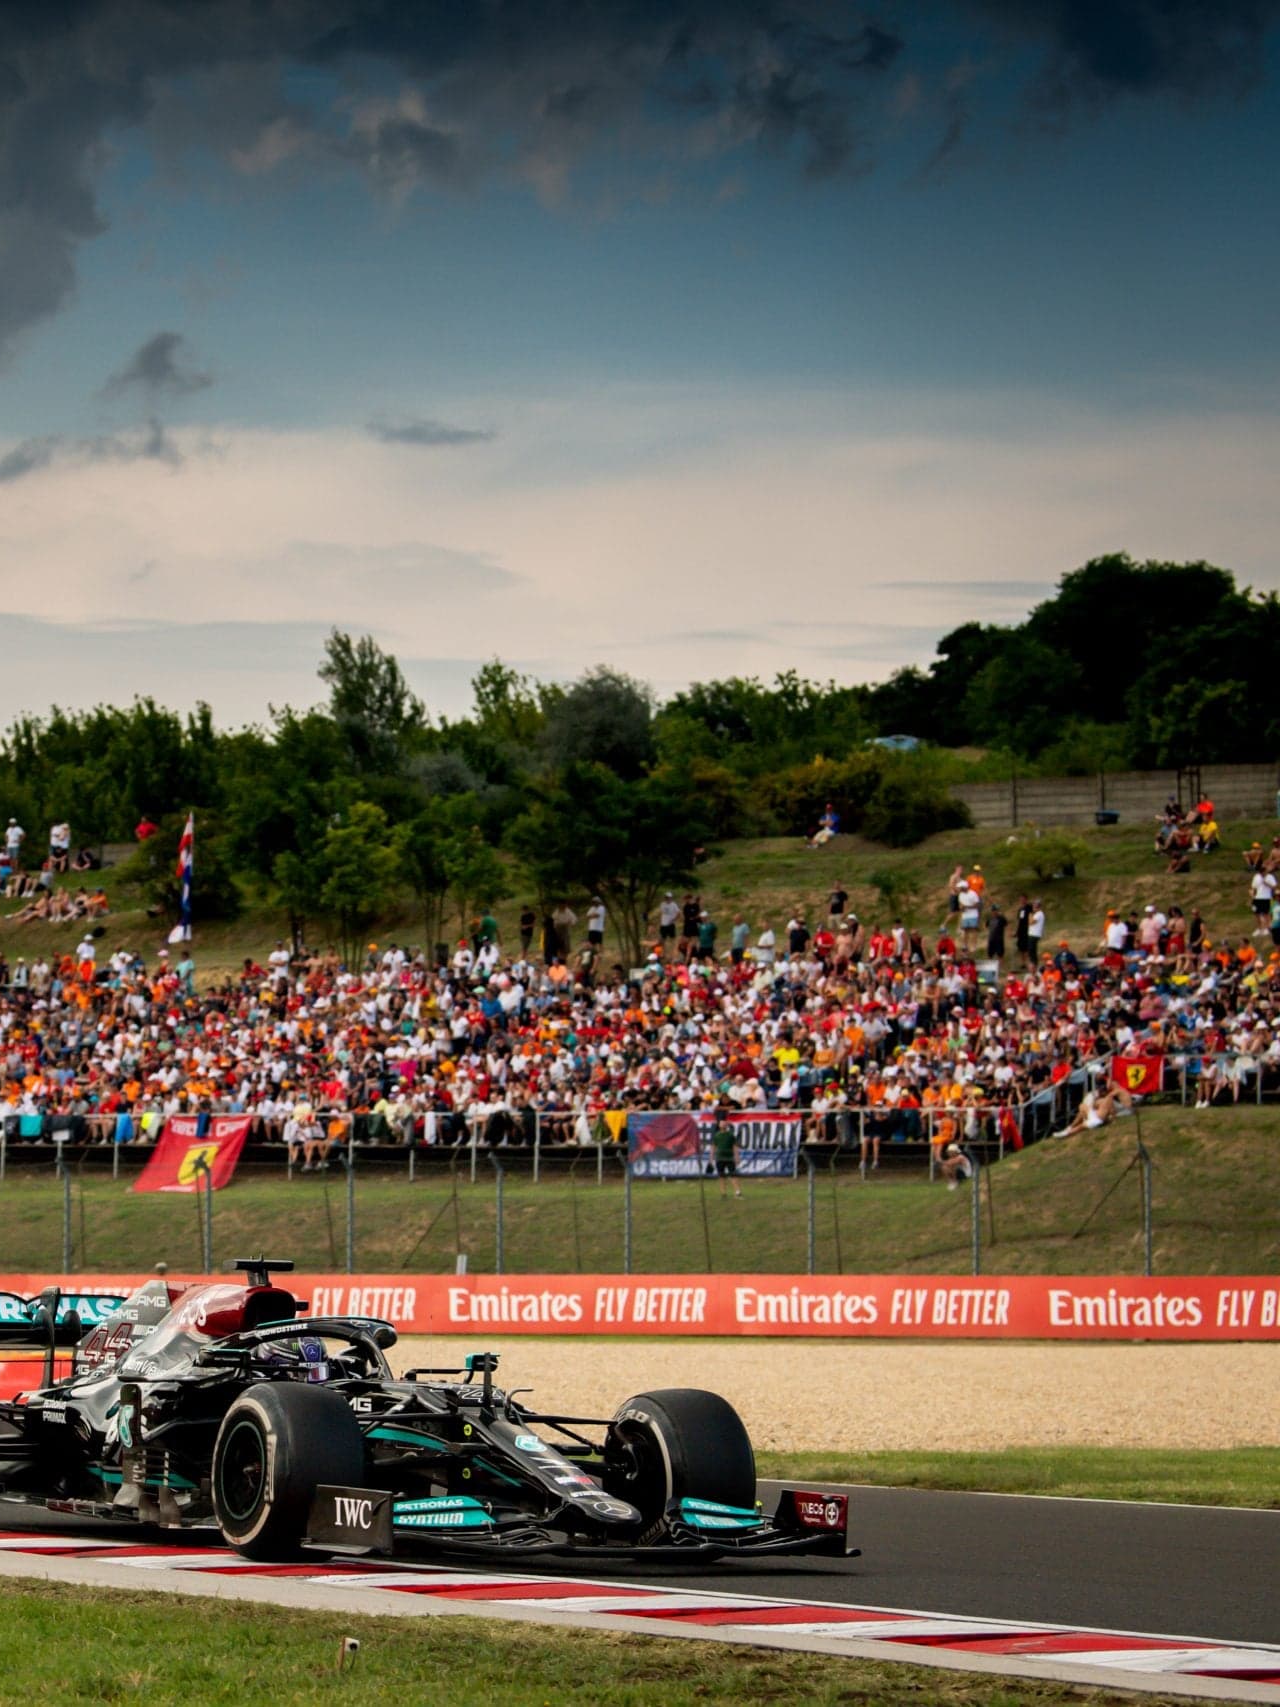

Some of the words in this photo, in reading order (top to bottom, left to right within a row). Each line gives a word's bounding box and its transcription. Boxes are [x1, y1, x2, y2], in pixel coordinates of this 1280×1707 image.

[137, 1295, 167, 1308] AMG
[312, 1287, 344, 1318] FLY
[347, 1288, 416, 1321] BETTER
[448, 1287, 583, 1322] Emirates
[595, 1287, 629, 1322] FLY
[632, 1288, 708, 1322] BETTER
[734, 1287, 878, 1324] Emirates
[890, 1289, 928, 1324] FLY
[932, 1289, 1010, 1325] BETTER
[1048, 1289, 1203, 1327] Emirates
[1217, 1289, 1256, 1327] FLY
[333, 1496, 373, 1530] IWC
[396, 1498, 465, 1511] PETRONAS
[398, 1512, 465, 1525] SYNTIUM
